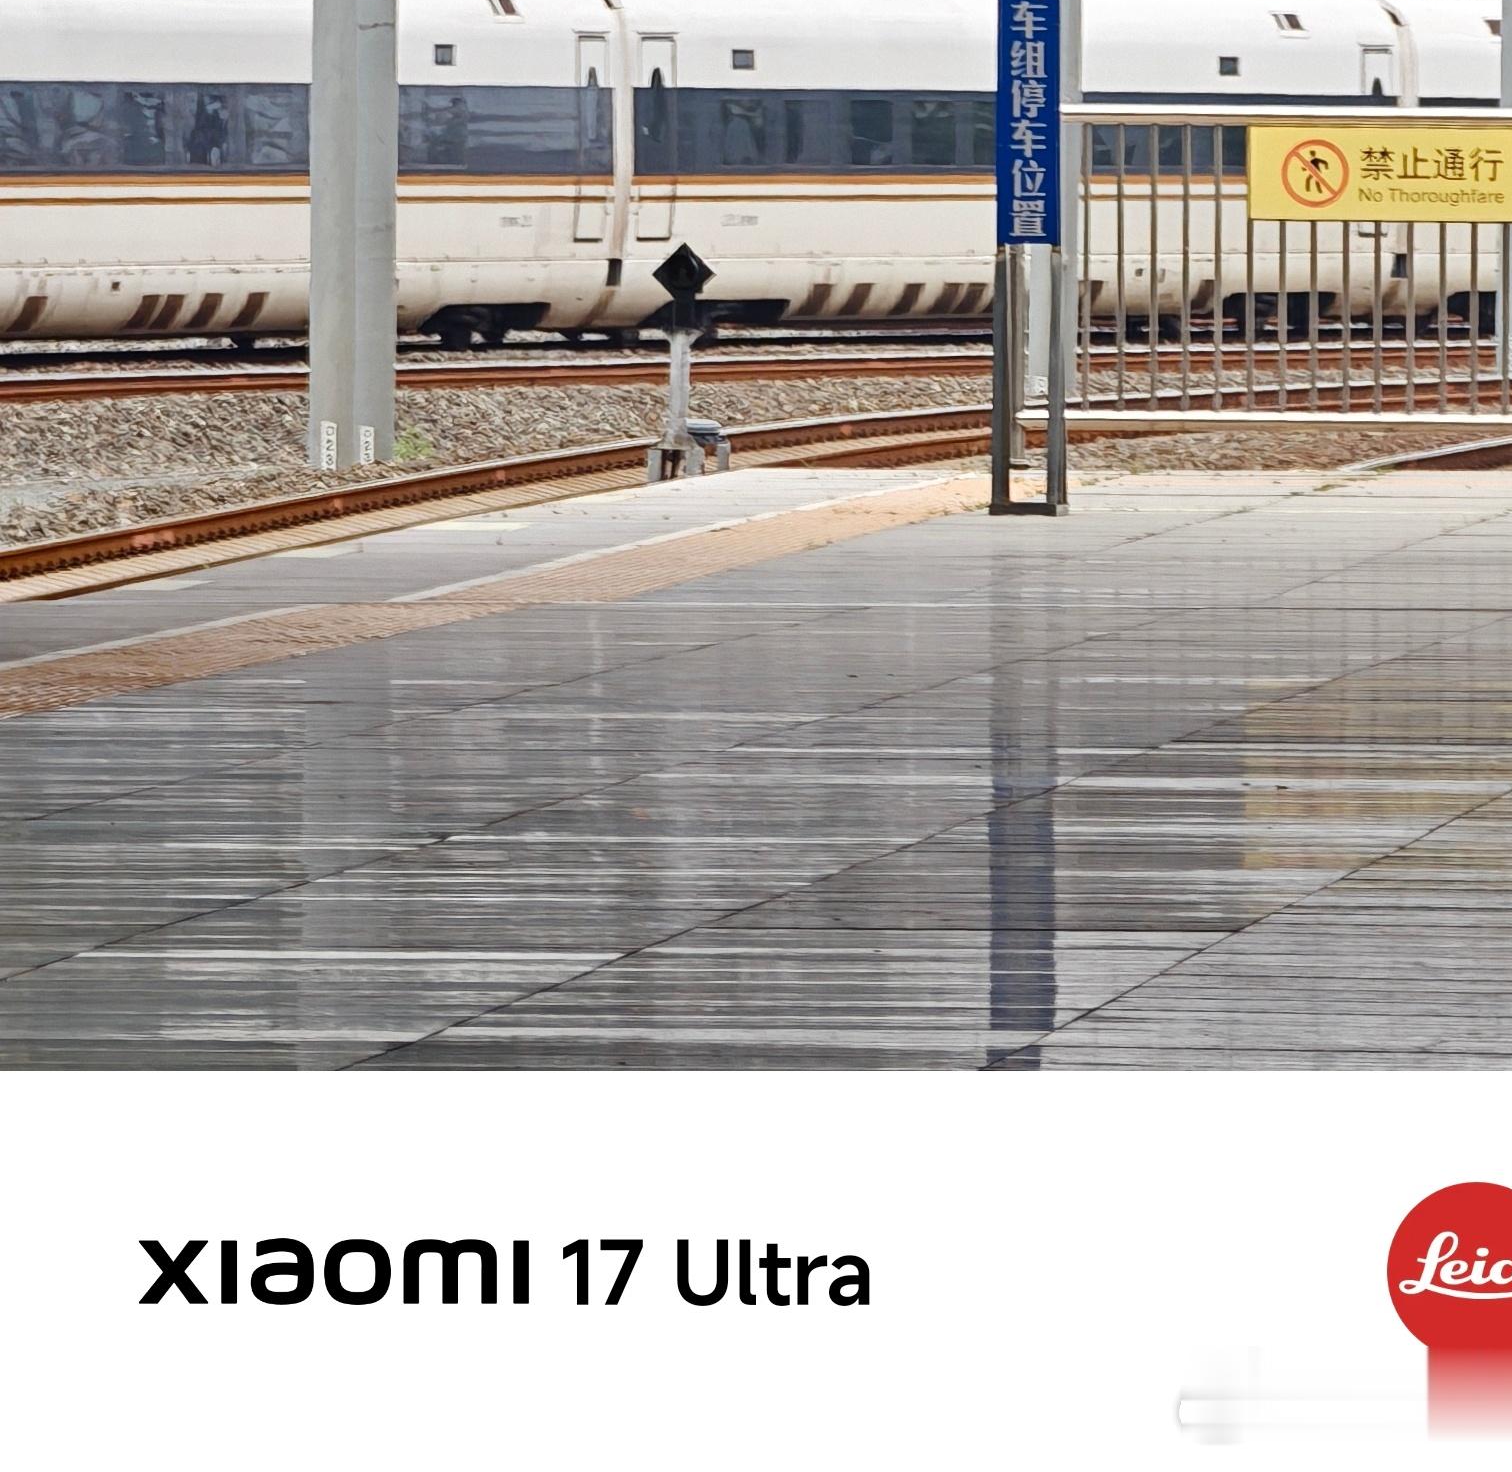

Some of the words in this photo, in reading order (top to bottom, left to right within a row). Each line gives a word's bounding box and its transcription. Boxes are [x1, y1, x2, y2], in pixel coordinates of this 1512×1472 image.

[1360, 146, 1504, 182] 禁止通行
[1358, 188, 1383, 203] No
[1388, 188, 1505, 207] Thoroughfare
